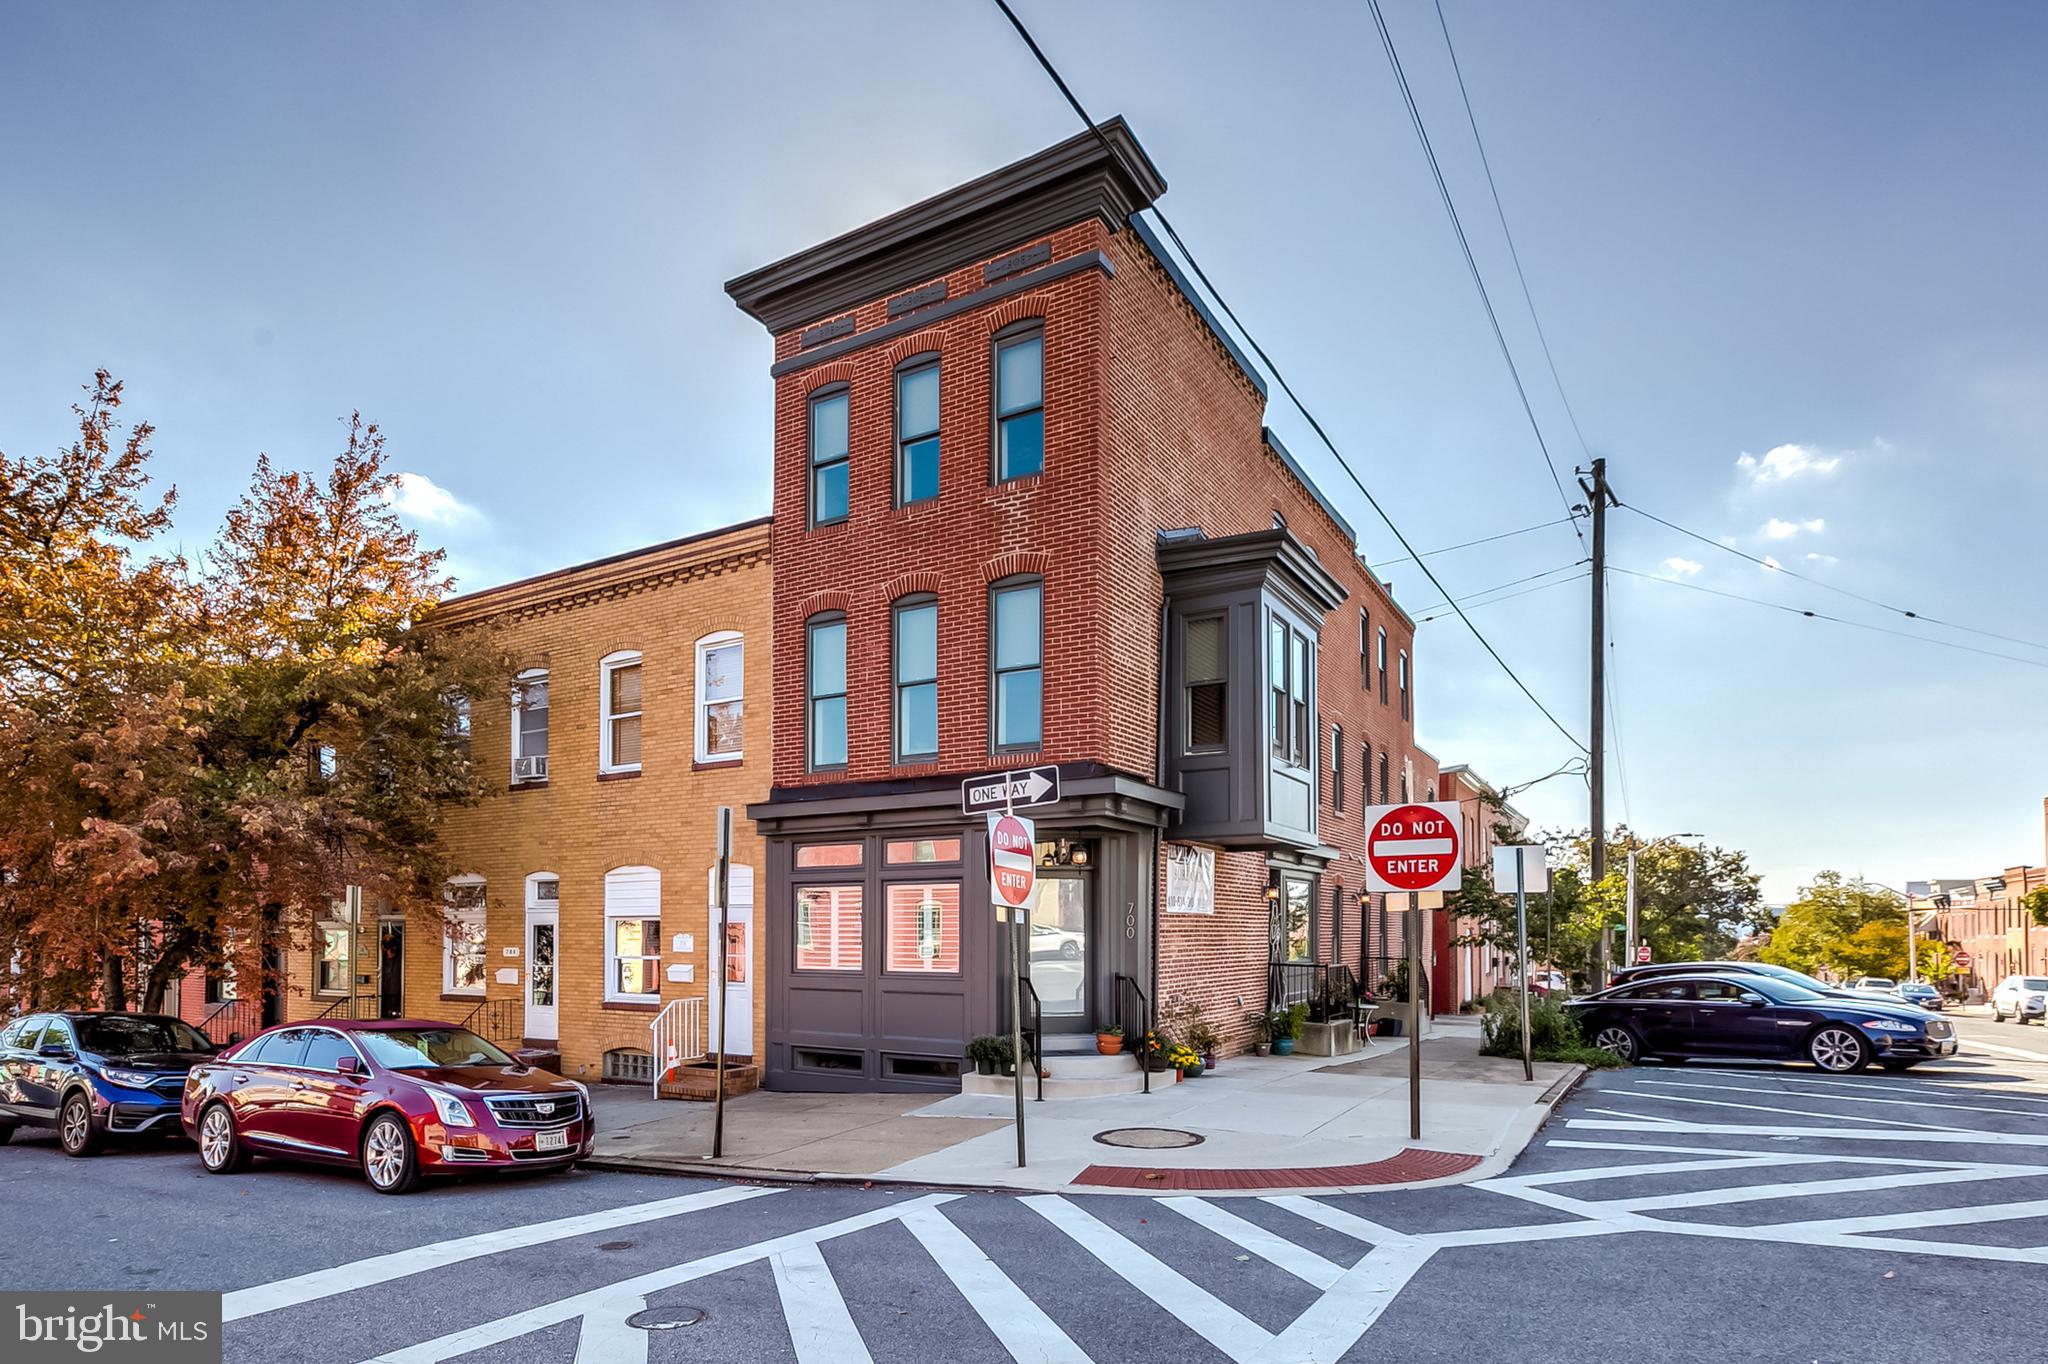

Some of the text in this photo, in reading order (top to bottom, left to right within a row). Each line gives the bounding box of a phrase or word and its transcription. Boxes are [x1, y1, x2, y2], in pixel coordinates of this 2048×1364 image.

[973, 788, 997, 802] ONE
[1381, 820, 1445, 836] DO NOT
[997, 830, 1028, 851] DO NOT
[1387, 859, 1439, 874] ENTER
[1001, 872, 1027, 889] ENTER
[1126, 902, 1135, 939] 700
